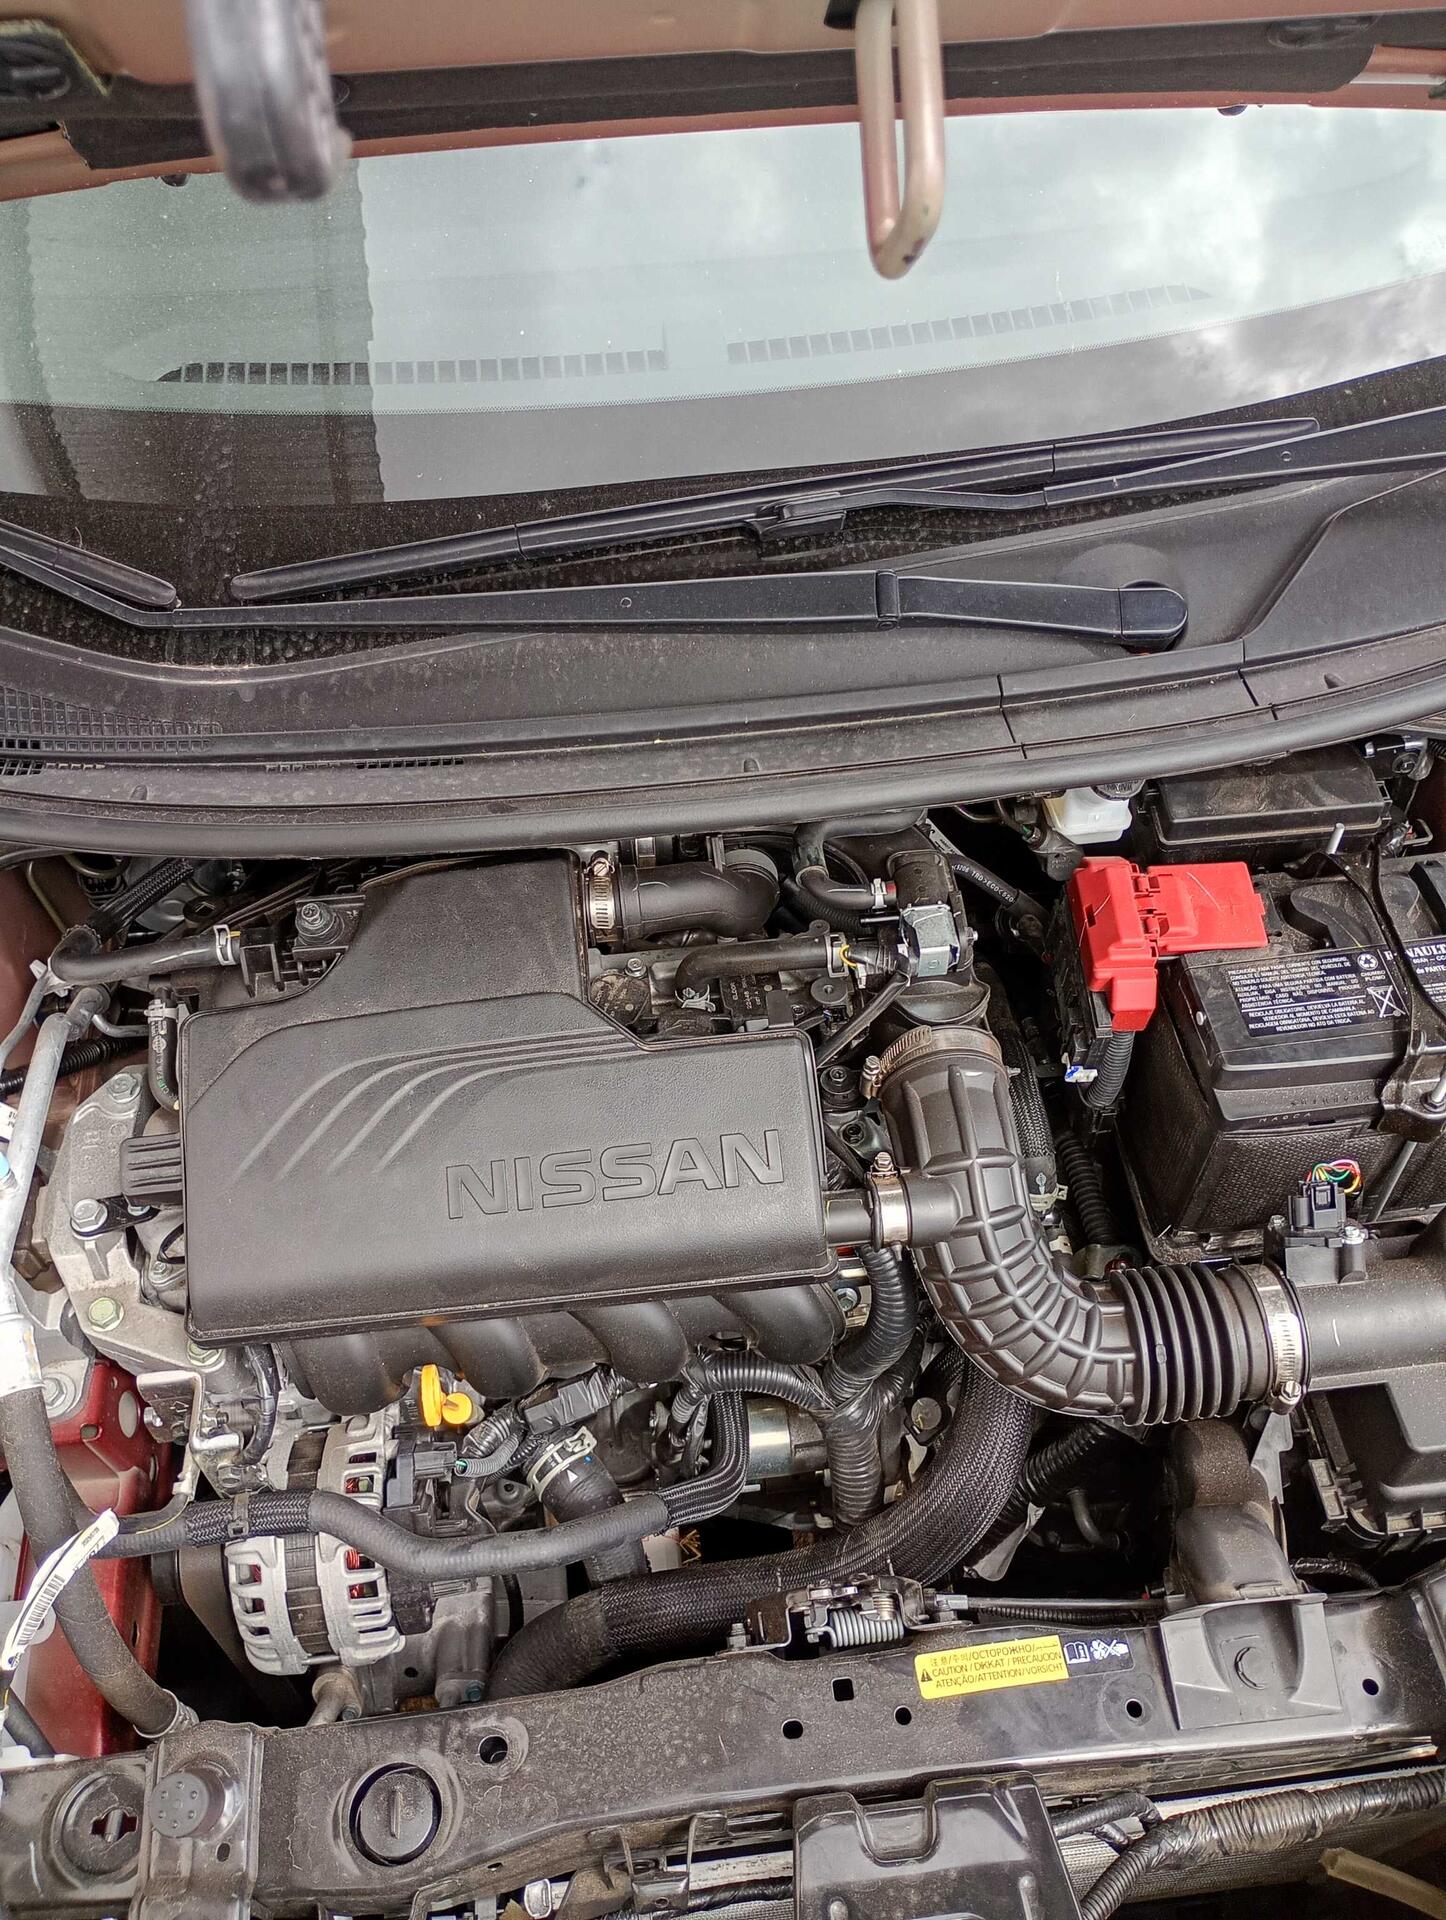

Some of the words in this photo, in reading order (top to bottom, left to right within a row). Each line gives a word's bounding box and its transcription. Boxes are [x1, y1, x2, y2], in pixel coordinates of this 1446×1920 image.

[1384, 944, 1446, 960] RNAULT
[446, 1129, 784, 1219] NISSAN
[932, 1665, 968, 1677] CAUTION
